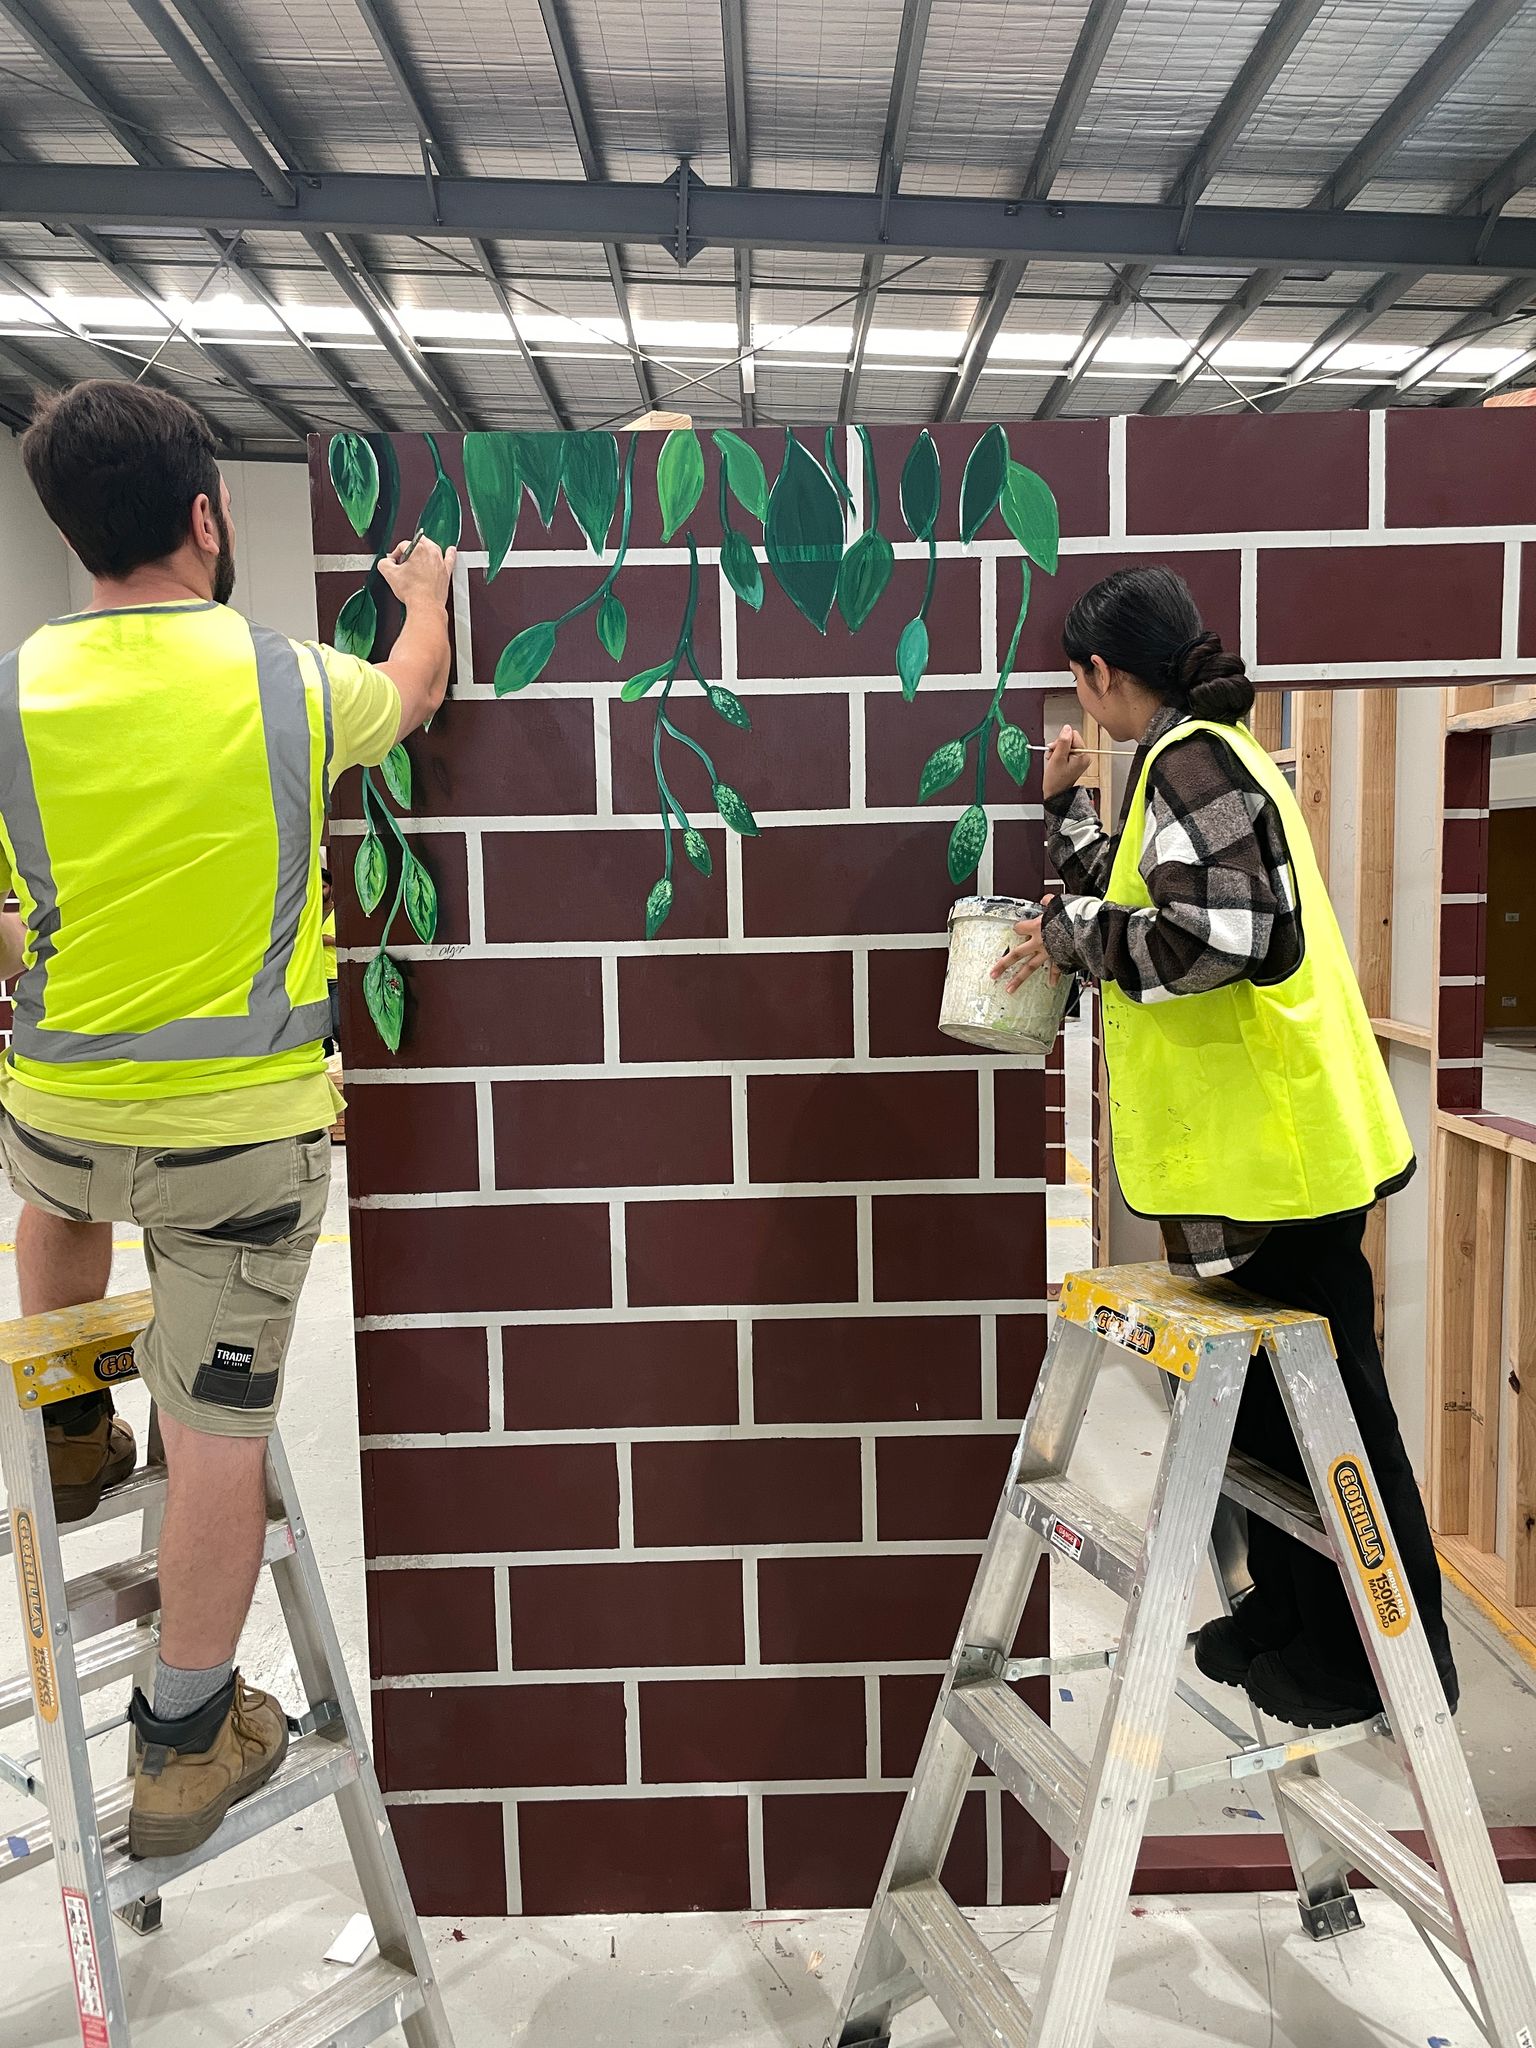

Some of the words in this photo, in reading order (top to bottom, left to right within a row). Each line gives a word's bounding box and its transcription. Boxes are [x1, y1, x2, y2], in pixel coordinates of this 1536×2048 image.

[100, 1350, 138, 1377] GO
[217, 1349, 252, 1363] TRADIE
[1337, 1466, 1383, 1567] GORILLA
[19, 1516, 44, 1632] GORILLA
[1375, 1573, 1401, 1622] 150KG
[1386, 1568, 1407, 1617] INDUSTRIAL
[1368, 1579, 1381, 1601] MAX
[1376, 1603, 1389, 1628] LOAD
[38, 1647, 51, 1706] 150KG
[43, 1647, 55, 1708] INDUSTRIAL
